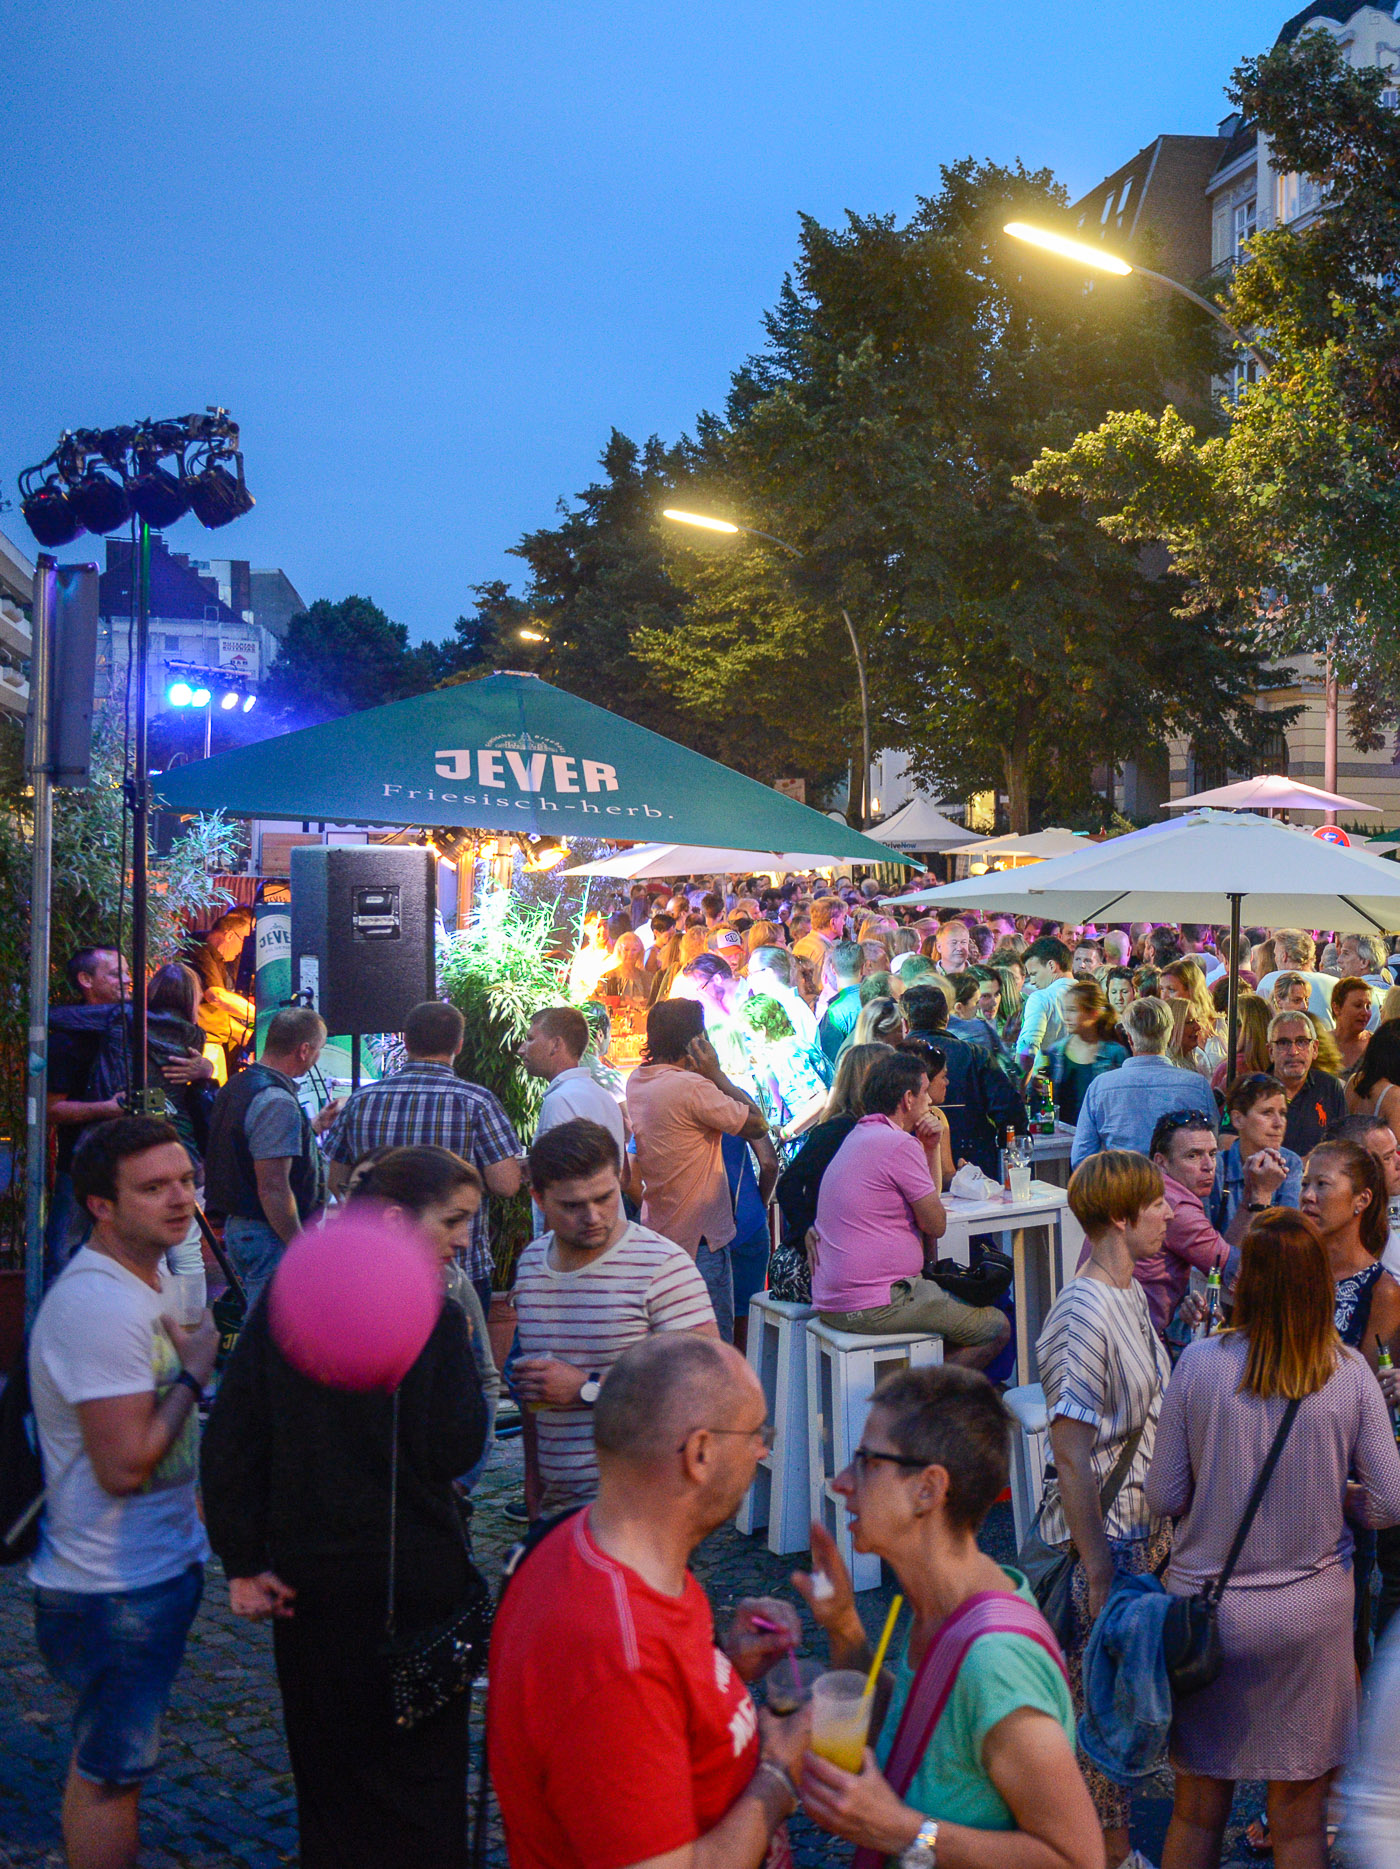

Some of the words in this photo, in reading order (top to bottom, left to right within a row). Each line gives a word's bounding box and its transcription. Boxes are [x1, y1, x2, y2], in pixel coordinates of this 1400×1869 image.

[435, 749, 619, 793] JEVER
[382, 783, 674, 819] Friesisch-herb.
[259, 930, 291, 948] JEVE
